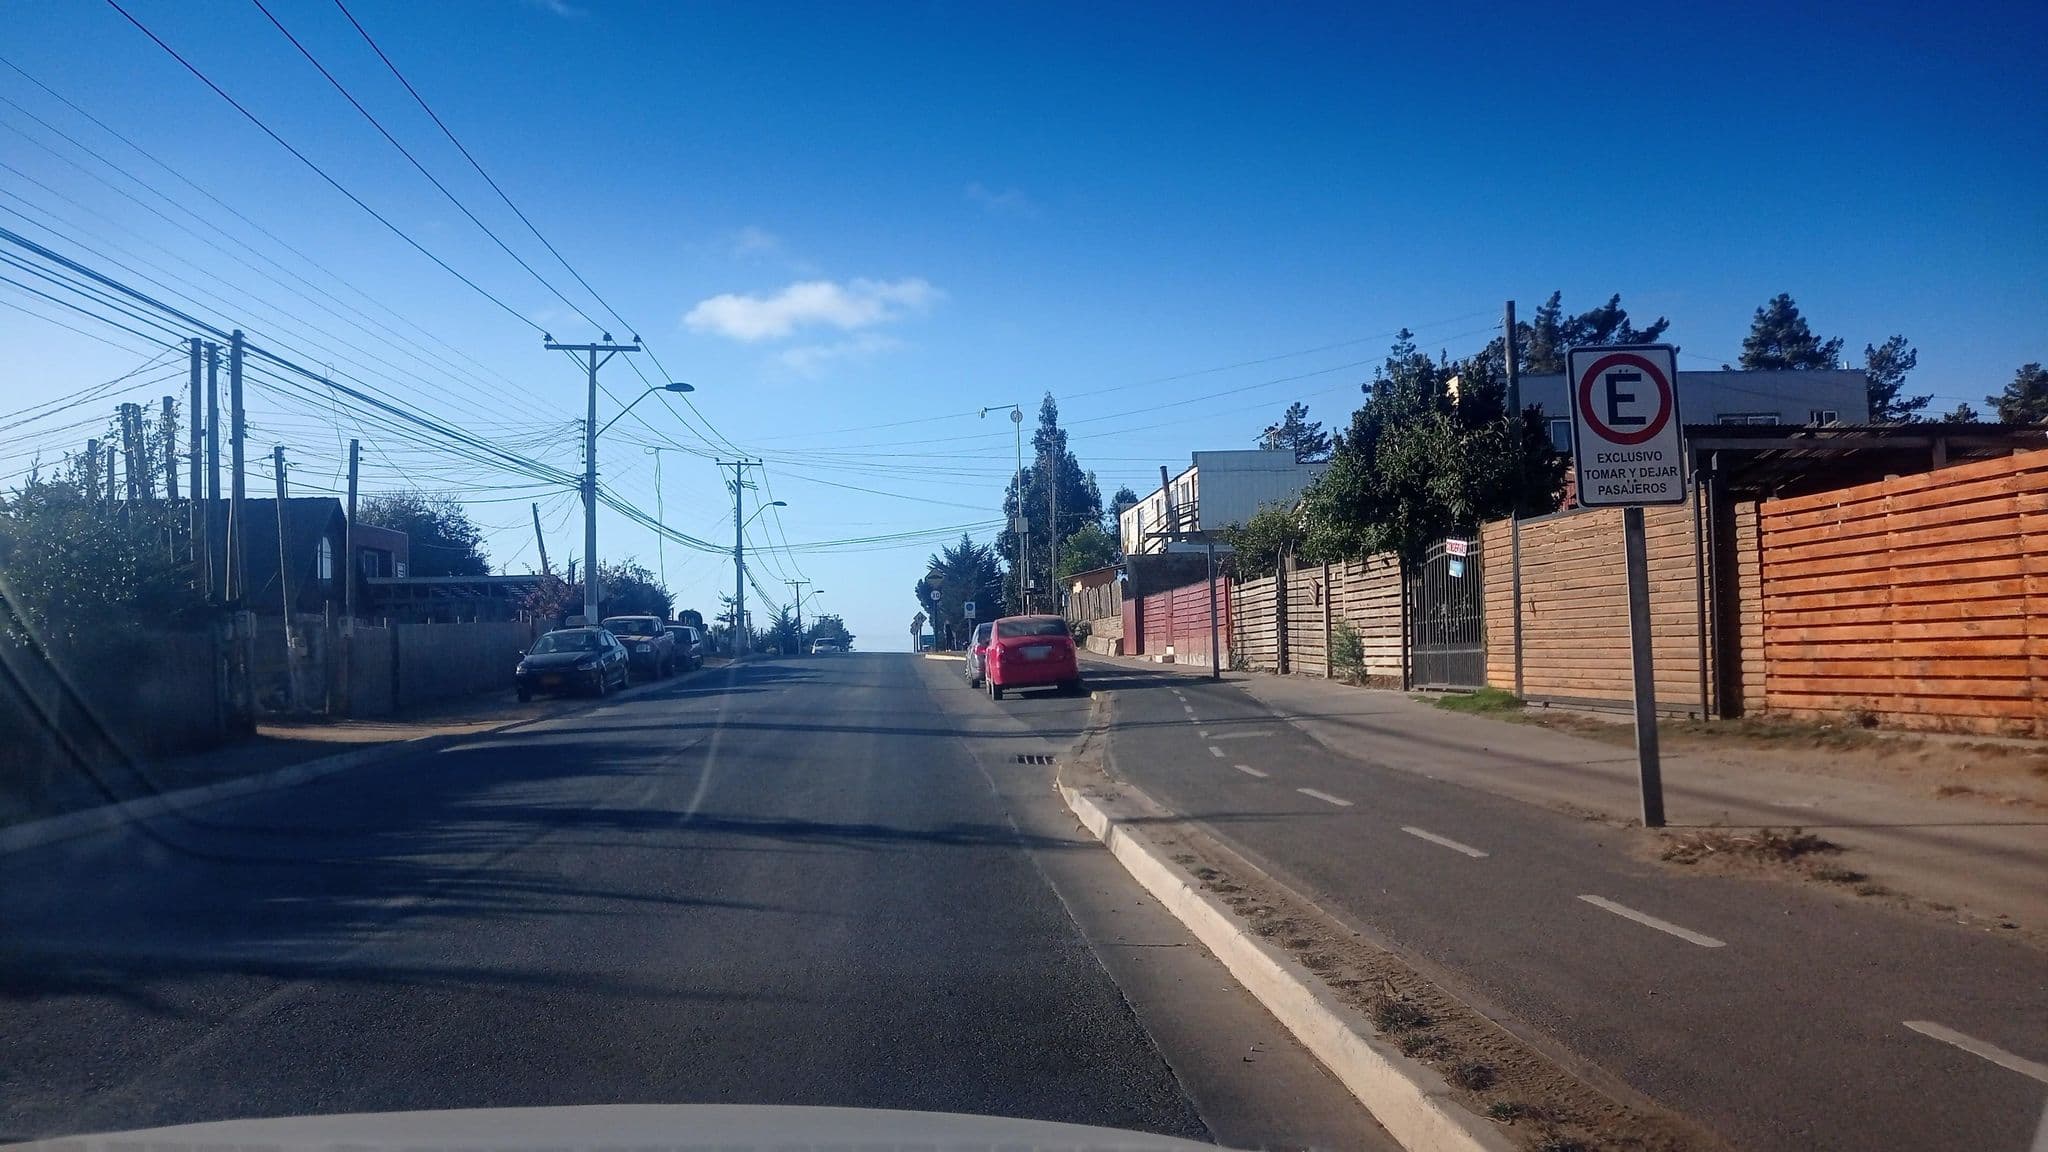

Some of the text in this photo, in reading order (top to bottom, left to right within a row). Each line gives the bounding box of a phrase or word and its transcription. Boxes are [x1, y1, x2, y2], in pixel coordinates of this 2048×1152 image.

[1606, 373, 1646, 425] E
[1597, 451, 1663, 463] EXCLUSIVO
[1584, 466, 1678, 480] TOMAR Y DEJAR
[1598, 483, 1667, 495] PASAJEROS
